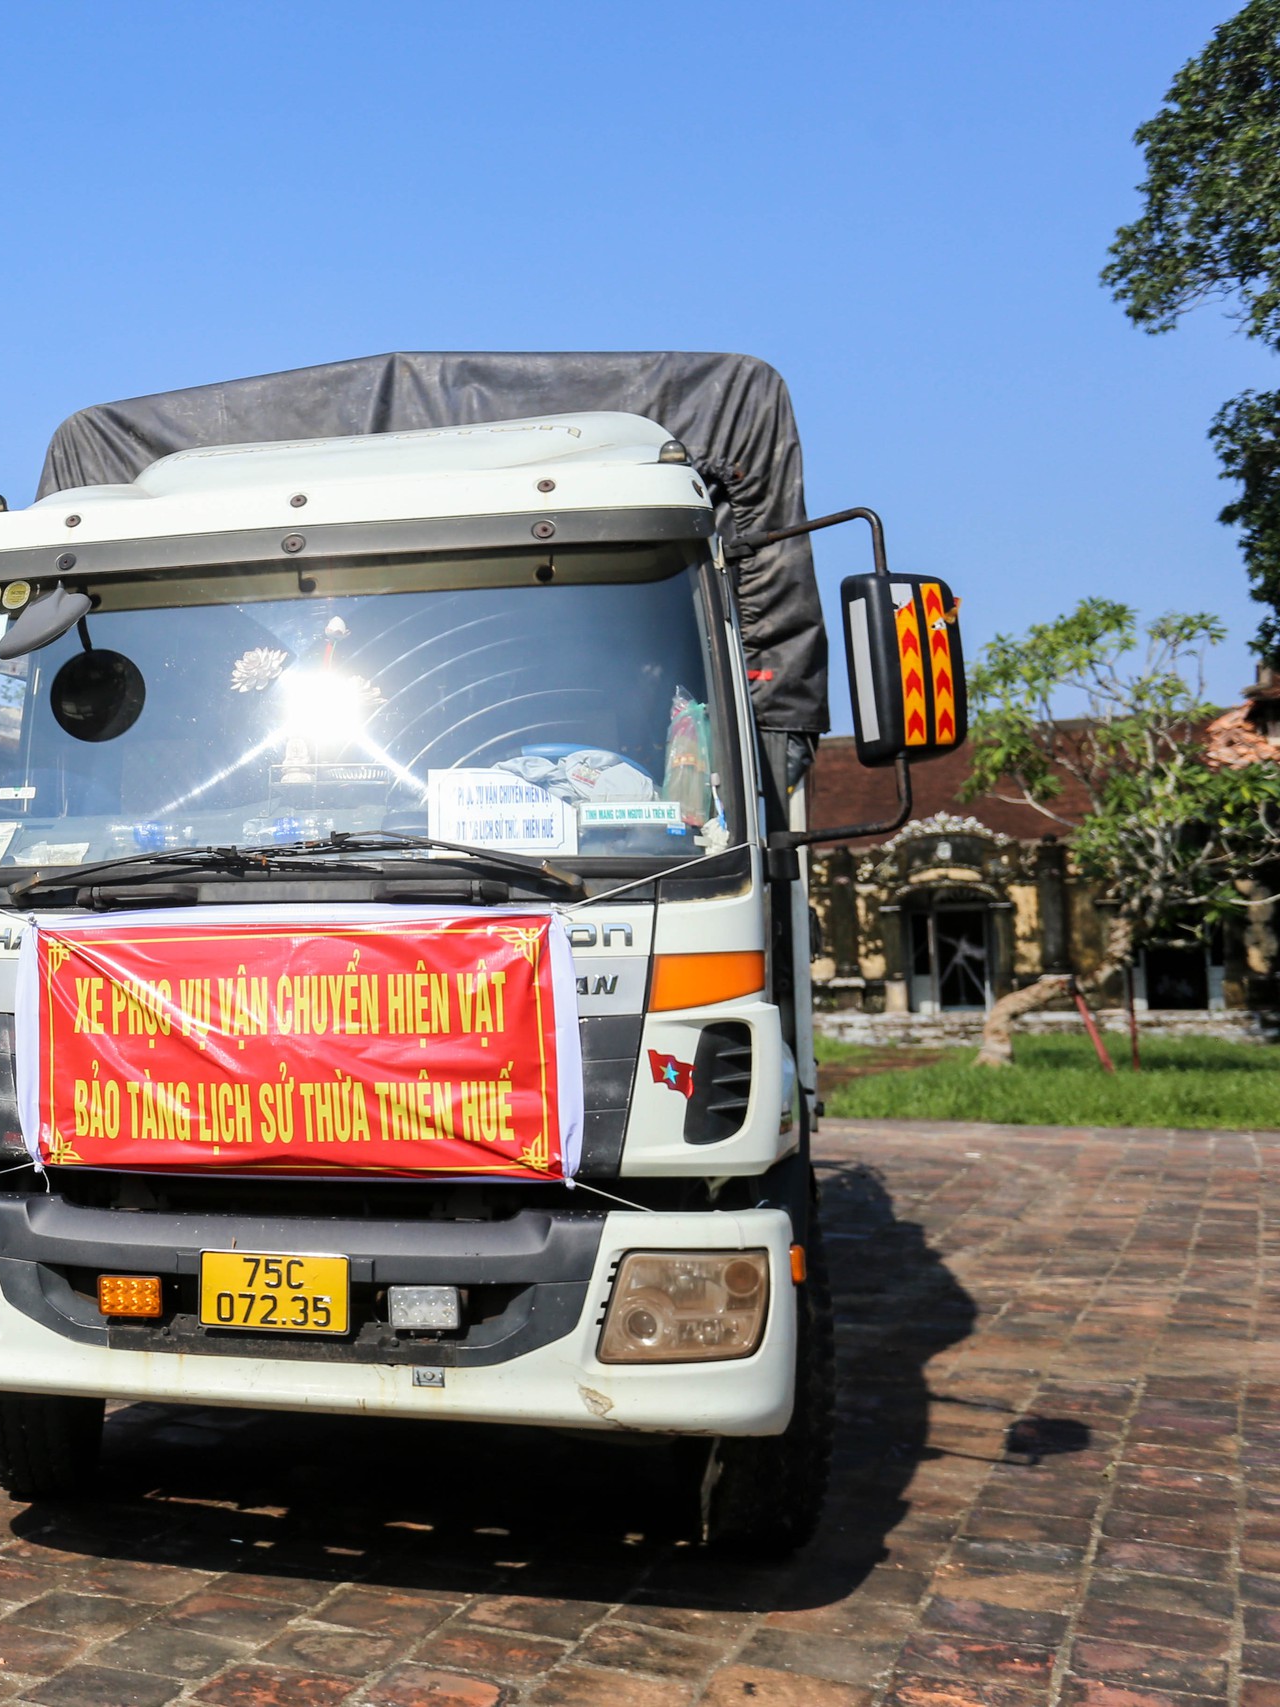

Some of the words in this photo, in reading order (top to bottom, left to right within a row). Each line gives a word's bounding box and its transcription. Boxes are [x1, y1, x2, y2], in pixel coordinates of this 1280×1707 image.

[485, 781, 498, 809] VẬN
[522, 814, 541, 839] THIÊN
[541, 811, 554, 839] HUẾ
[73, 977, 105, 1035] XE
[110, 978, 172, 1049] PHỤC
[179, 978, 211, 1050] VỤ
[217, 964, 268, 1050] VẬN
[276, 948, 380, 1035] CHUYỂN
[387, 960, 451, 1049] HIỆN
[456, 959, 506, 1048] VẬT
[74, 1059, 120, 1139] BẢO
[126, 1069, 192, 1141] TÀNG
[197, 1082, 253, 1156] LỊCH
[258, 1062, 295, 1144] SỬ
[299, 1069, 371, 1143] THỪA
[374, 1069, 455, 1141] THIÊN
[460, 1060, 515, 1142] HUẾ
[243, 1257, 305, 1290] 75C
[216, 1291, 332, 1327] 072.35
